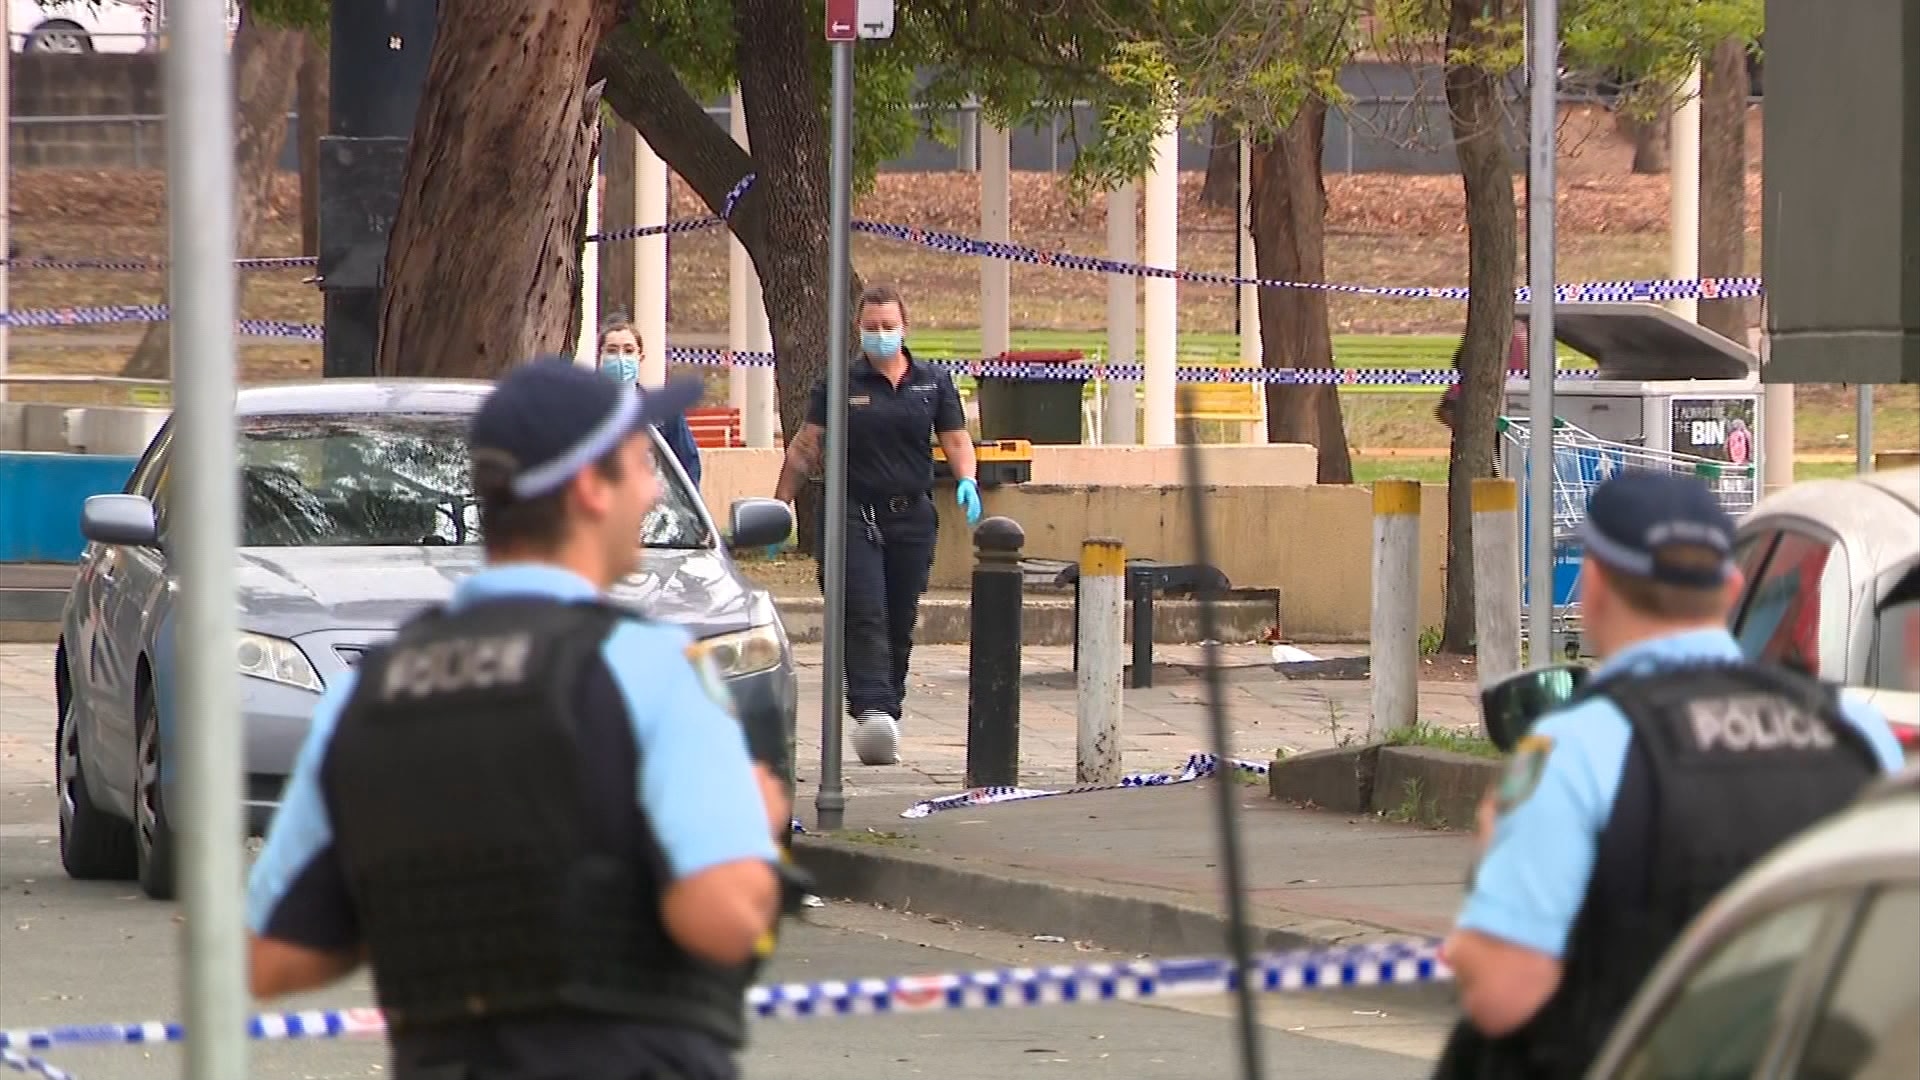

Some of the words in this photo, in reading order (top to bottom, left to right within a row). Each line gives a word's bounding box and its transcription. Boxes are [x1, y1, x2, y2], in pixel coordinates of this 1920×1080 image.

[1674, 421, 1690, 432] THE
[1691, 420, 1725, 445] BIN
[384, 633, 533, 702] POLICE
[1688, 694, 1836, 752] POLICE
